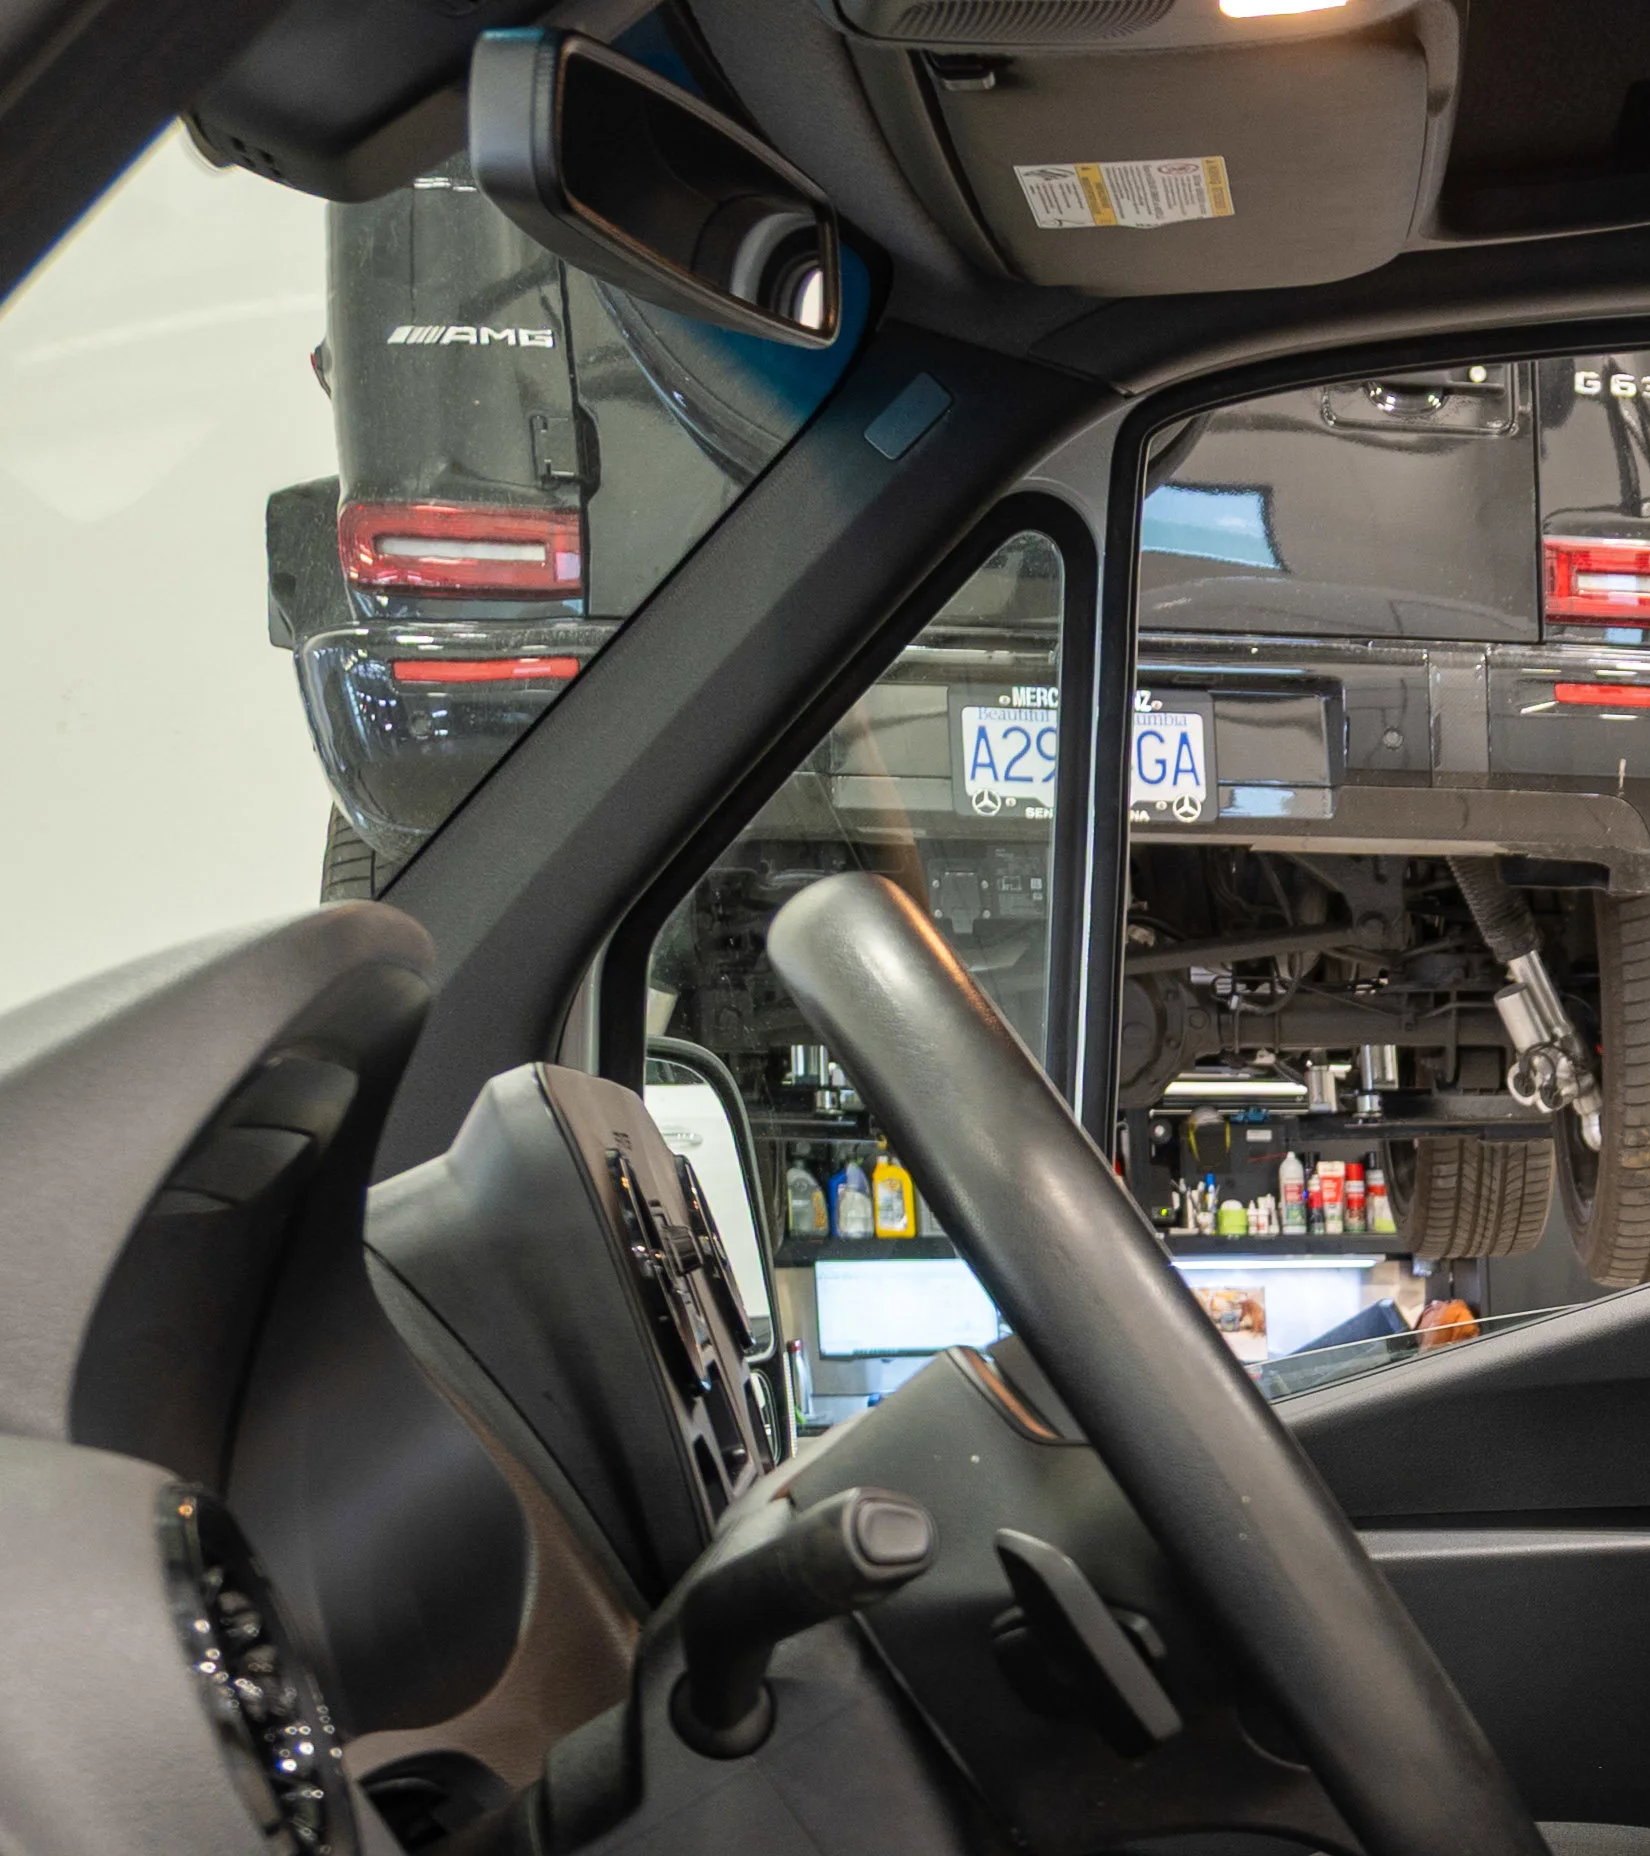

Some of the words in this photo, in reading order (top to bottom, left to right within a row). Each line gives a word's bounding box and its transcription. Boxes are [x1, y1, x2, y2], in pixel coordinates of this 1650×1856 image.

[439, 325, 554, 348] AMG
[1574, 370, 1601, 395] G
[1011, 686, 1058, 707] MERC
[1134, 711, 1188, 726] umbia
[1135, 729, 1201, 788] GA
[1025, 806, 1054, 820] SEN
[1130, 809, 1150, 823] NA
